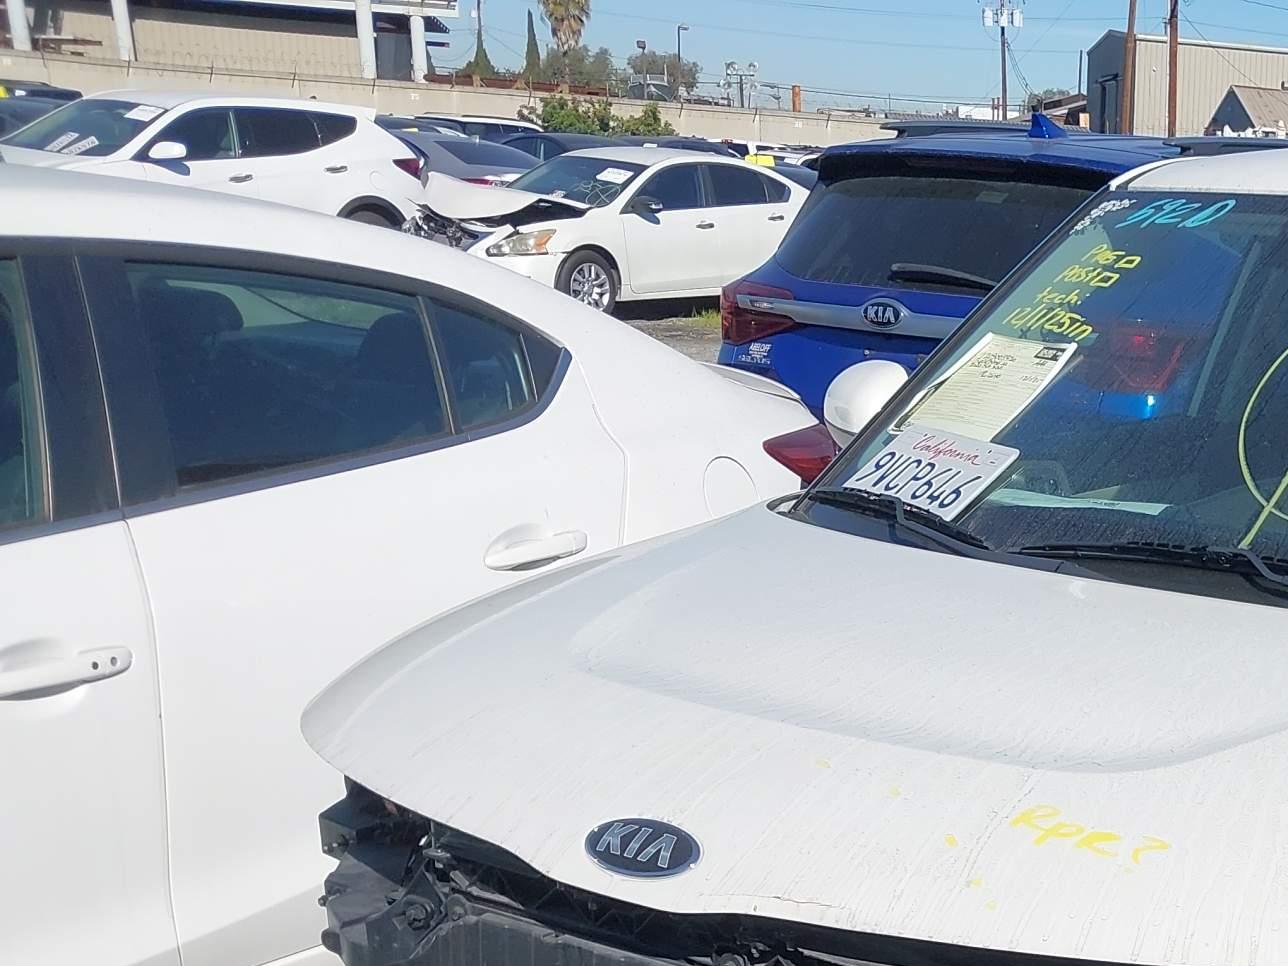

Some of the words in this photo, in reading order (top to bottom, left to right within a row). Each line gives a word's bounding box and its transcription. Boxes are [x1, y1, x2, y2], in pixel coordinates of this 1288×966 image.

[867, 305, 896, 323] KIA
[912, 435, 982, 467] California
[855, 451, 983, 509] 9VCP646
[596, 822, 677, 869] KIA
